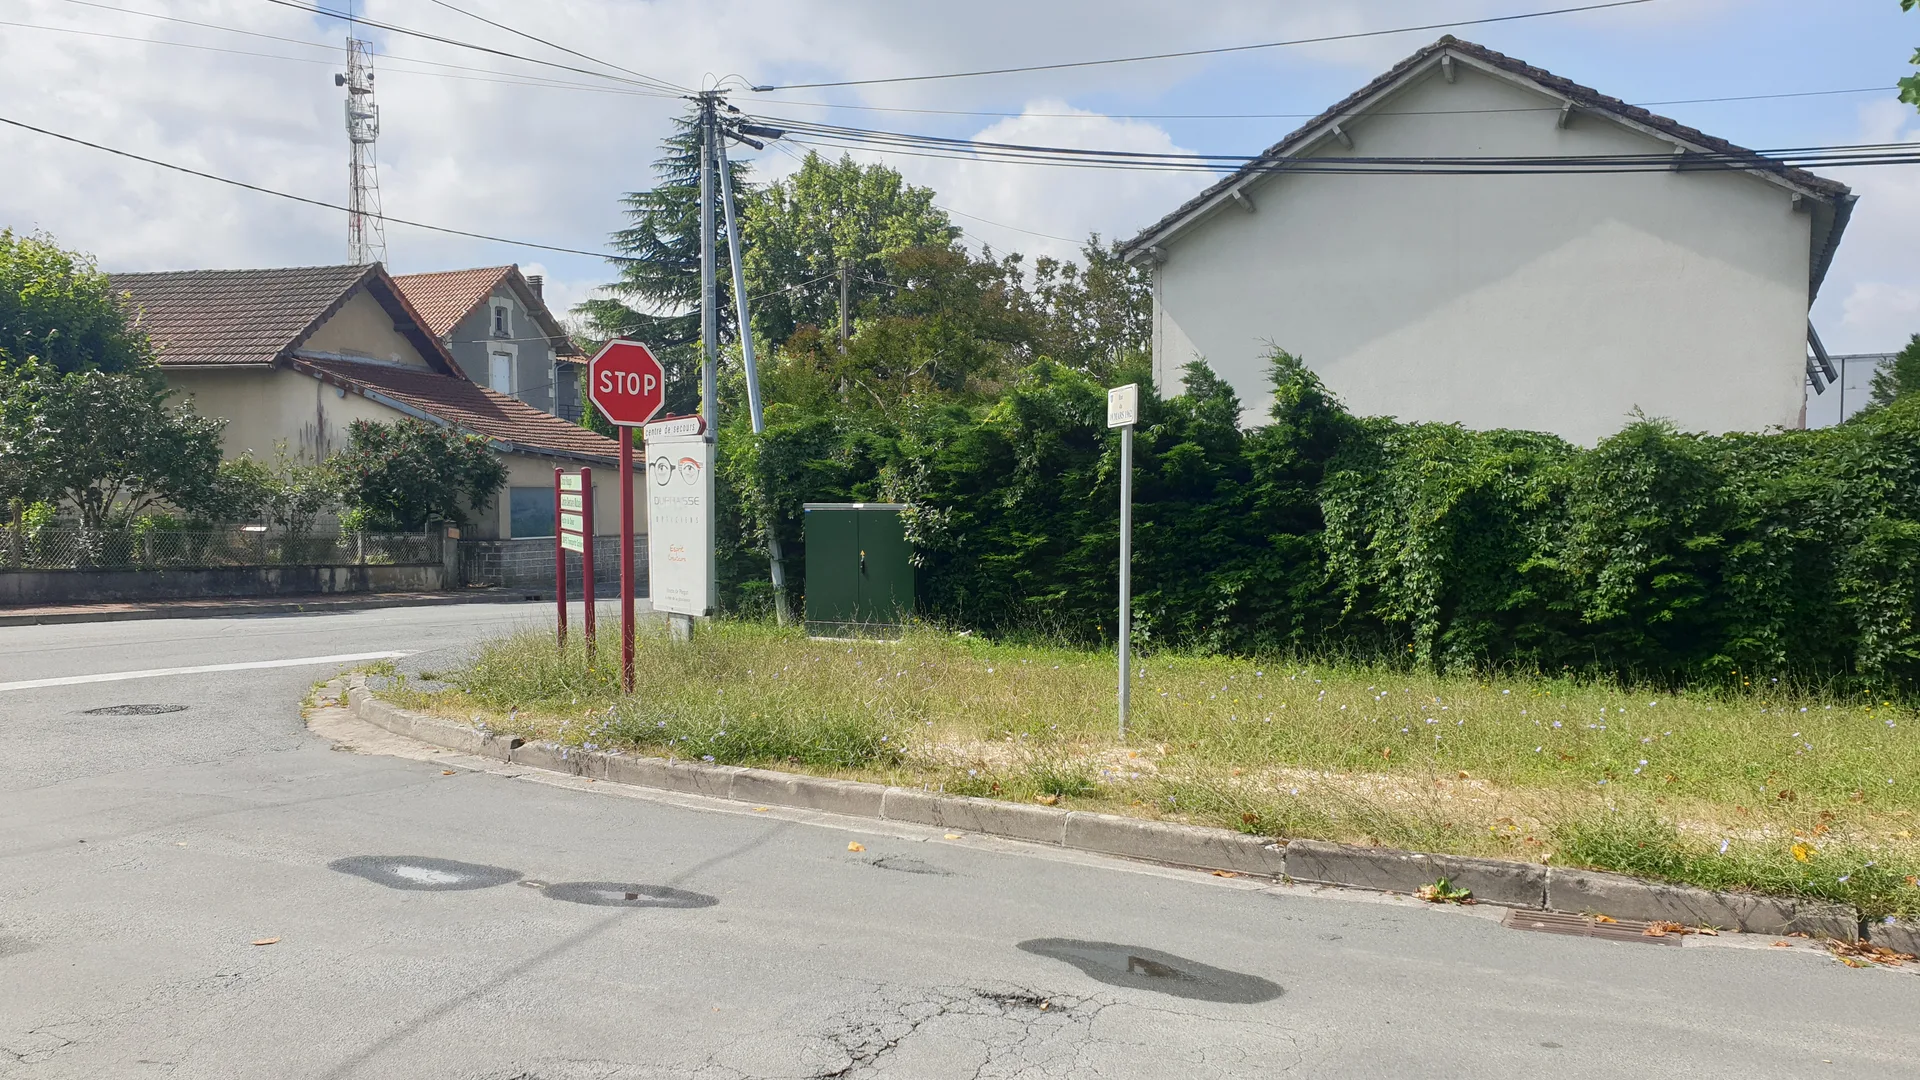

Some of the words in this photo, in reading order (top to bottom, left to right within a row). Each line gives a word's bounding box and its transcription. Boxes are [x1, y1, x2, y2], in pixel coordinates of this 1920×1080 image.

[599, 369, 656, 396] STOP
[645, 427, 662, 437] centre
[664, 425, 671, 434] de
[673, 423, 696, 433] secours
